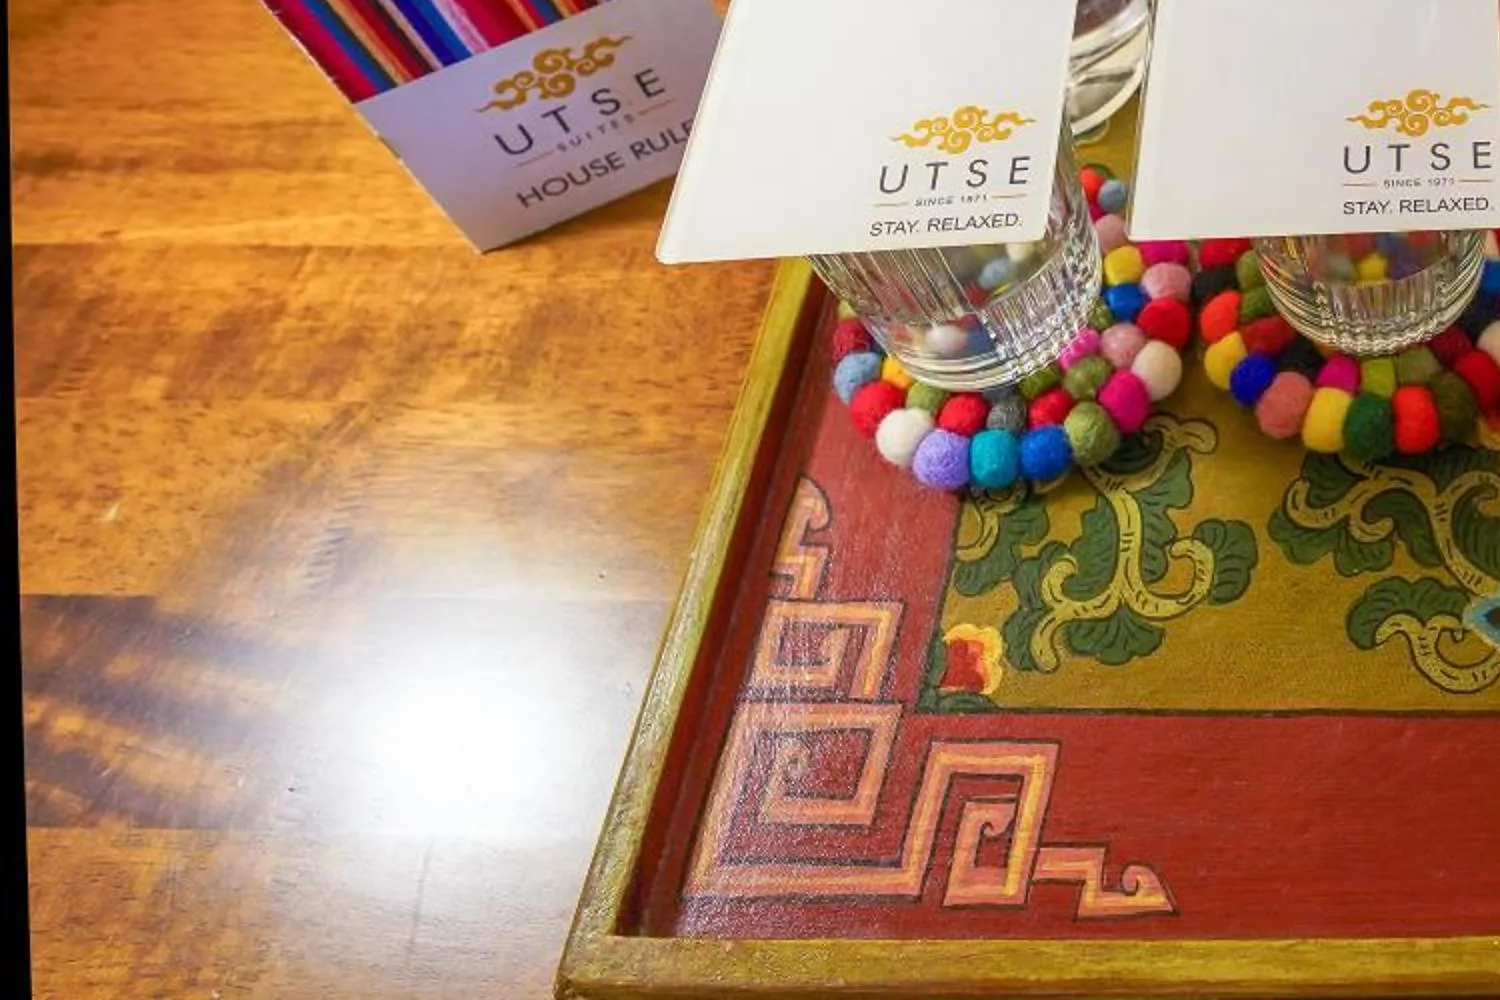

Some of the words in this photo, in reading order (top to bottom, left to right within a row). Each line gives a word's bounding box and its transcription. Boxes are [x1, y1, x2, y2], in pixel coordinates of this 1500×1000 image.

[493, 68, 666, 157] UTSE
[1343, 141, 1492, 174] UTSE
[516, 151, 626, 208] HOUSE
[879, 156, 1031, 194] UTSE
[1383, 178, 1421, 189] SINCE
[914, 194, 954, 207] SINCE
[1399, 196, 1495, 214] RELAXED.
[927, 212, 1023, 233] RELAXED.
